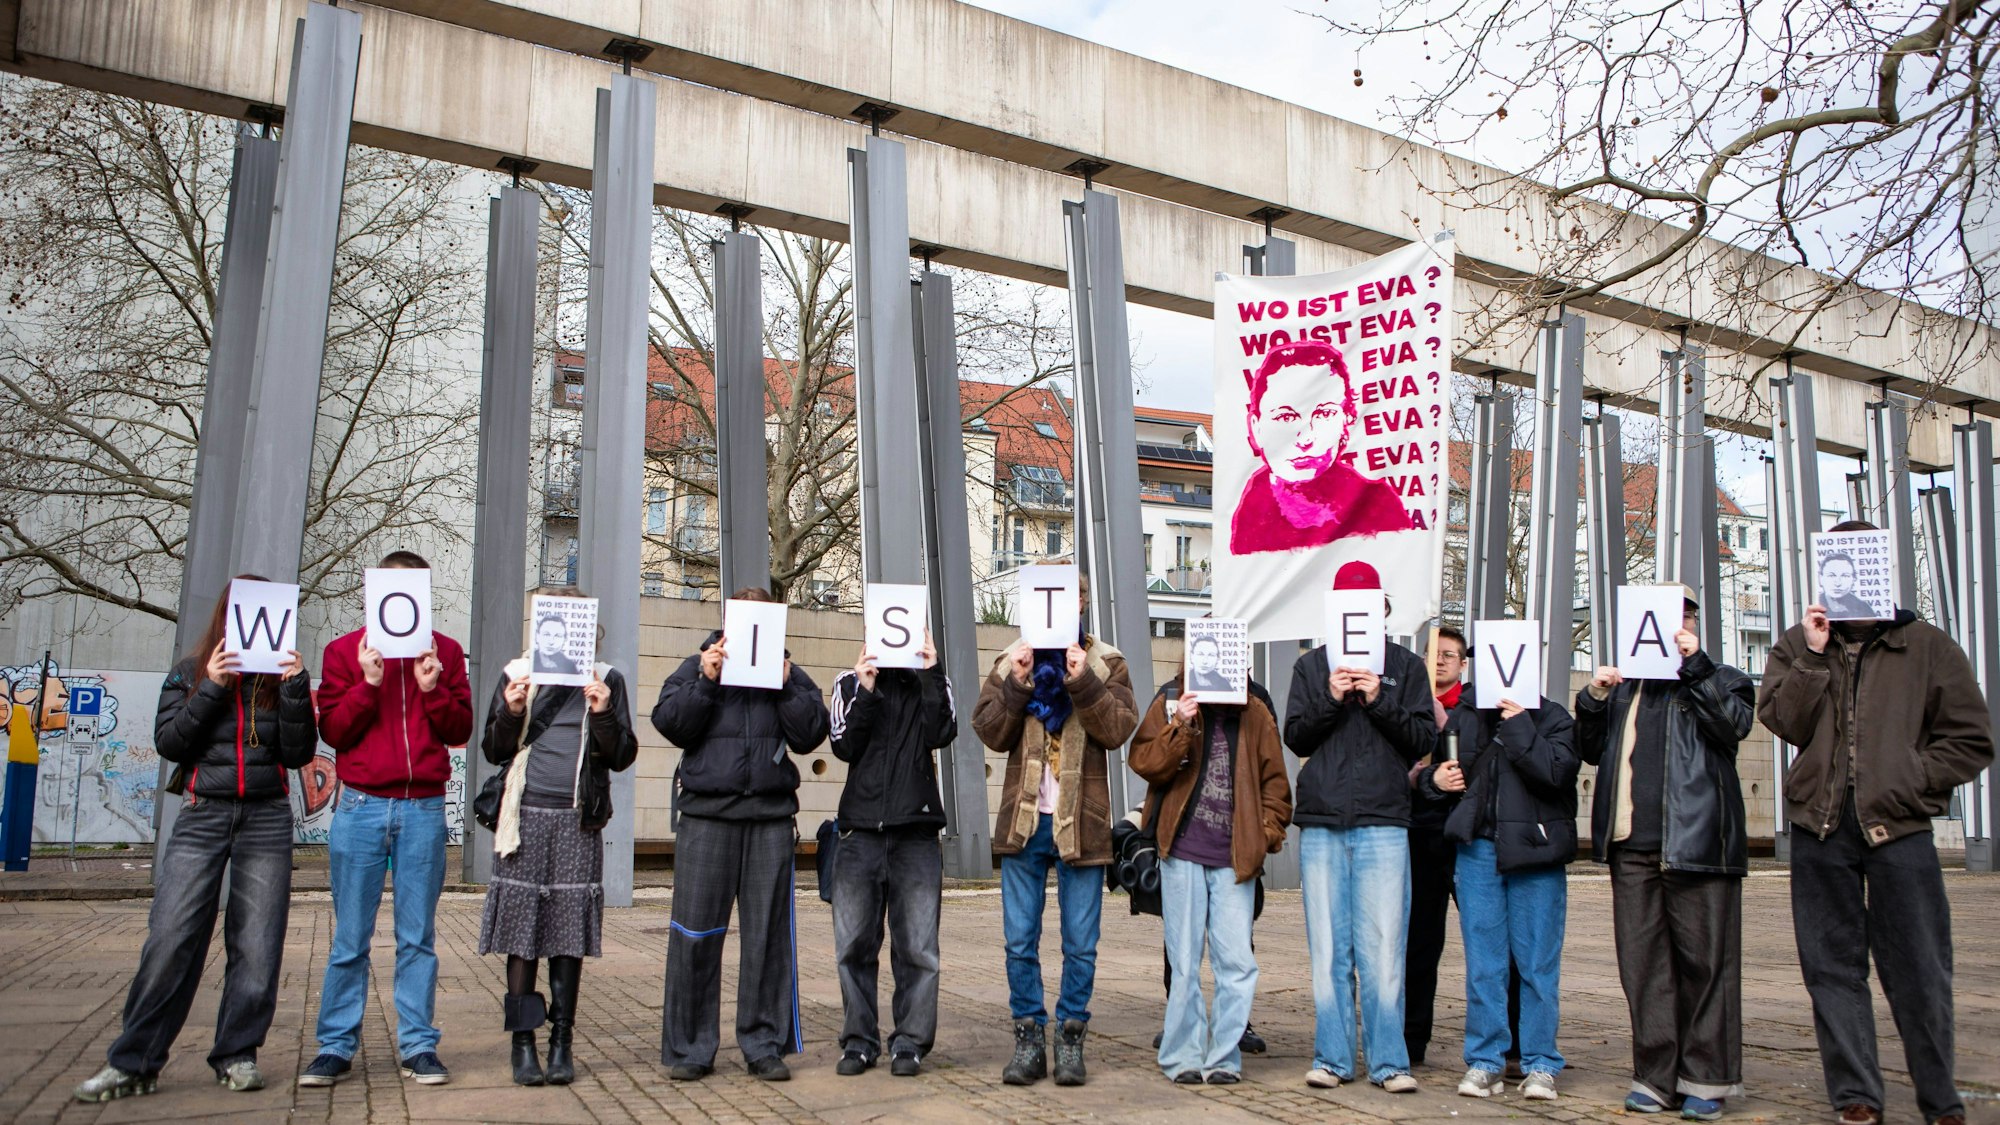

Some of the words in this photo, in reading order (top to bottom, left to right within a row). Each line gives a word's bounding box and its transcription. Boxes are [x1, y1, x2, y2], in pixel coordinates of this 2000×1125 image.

[1238, 301, 1289, 323] WO
[1298, 290, 1348, 317] IST
[1357, 275, 1417, 306] EVA
[1424, 266, 1441, 288] ?
[1360, 308, 1416, 339] EVA
[1424, 302, 1442, 324] ?
[1362, 341, 1418, 373] EVA
[1425, 337, 1441, 358] ?
[1362, 375, 1420, 404] EVA
[1427, 371, 1440, 394] ?
[1364, 408, 1424, 437] EVA
[1429, 404, 1441, 427] ?
[1367, 442, 1424, 472] EVA
[1430, 441, 1440, 463] ?
[1837, 537, 1854, 545] IST
[235, 604, 291, 651] W
[379, 593, 419, 637] O
[881, 607, 910, 648] S
[1034, 587, 1064, 628] T
[1343, 613, 1369, 655] E
[1631, 611, 1668, 657] A
[1489, 644, 1525, 687] V
[76, 690, 94, 712] P
